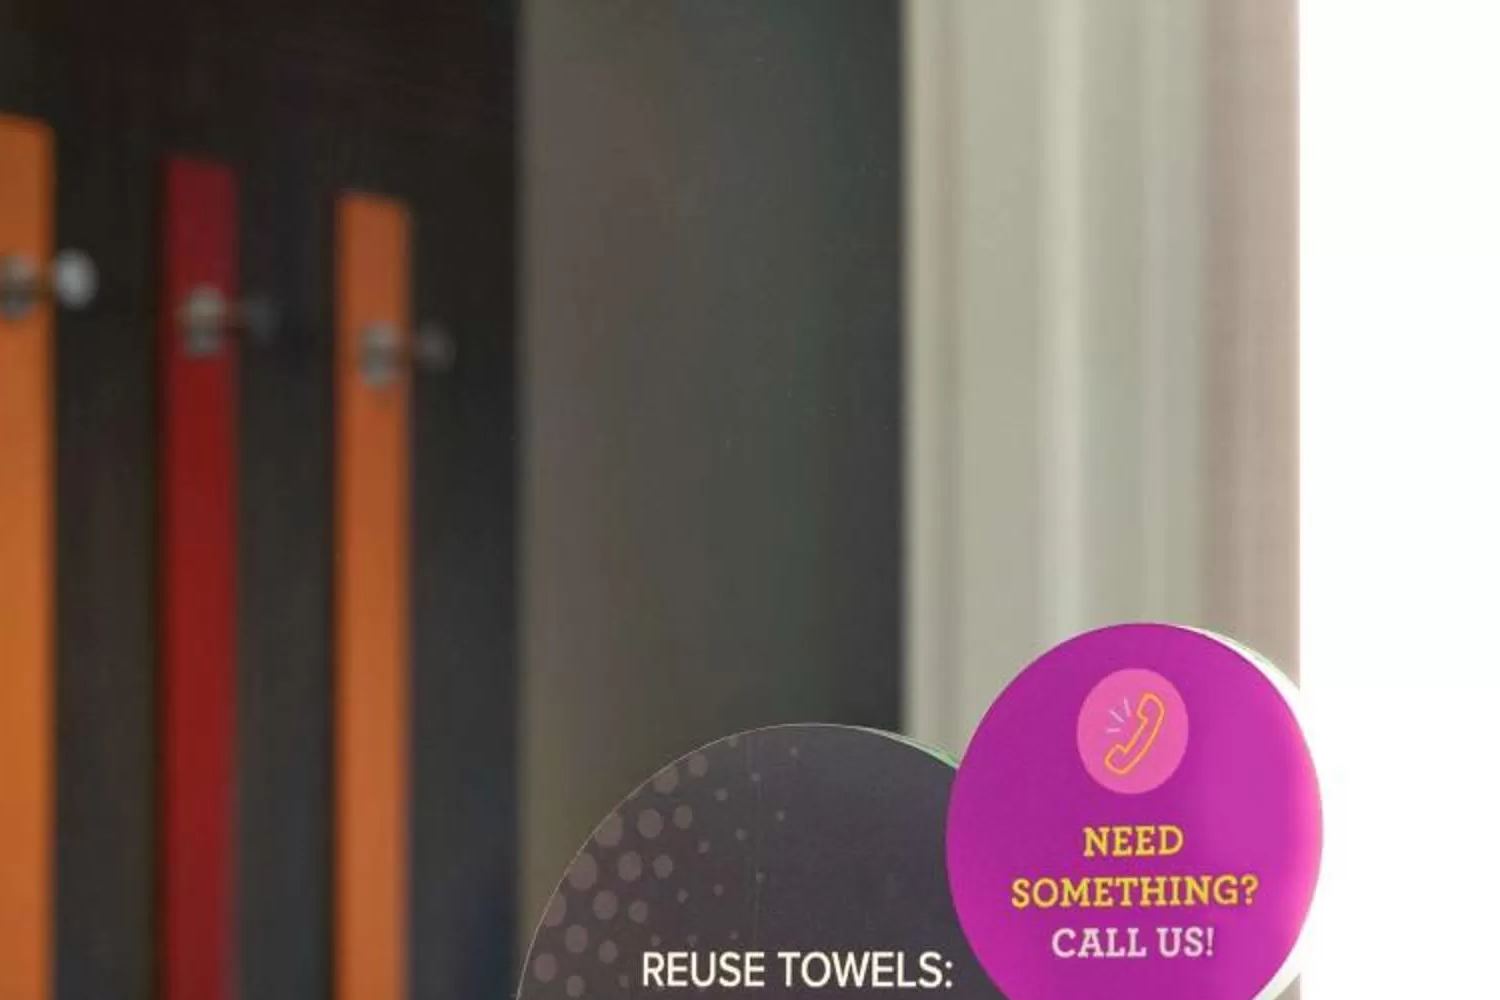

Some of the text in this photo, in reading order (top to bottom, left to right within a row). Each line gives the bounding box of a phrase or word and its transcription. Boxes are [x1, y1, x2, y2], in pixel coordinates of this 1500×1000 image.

[1083, 825, 1184, 857] NEED
[1011, 874, 1260, 909] SOMETHING?
[1051, 926, 1216, 958] CALL US!
[642, 951, 953, 989] REUSE TOWELS:
